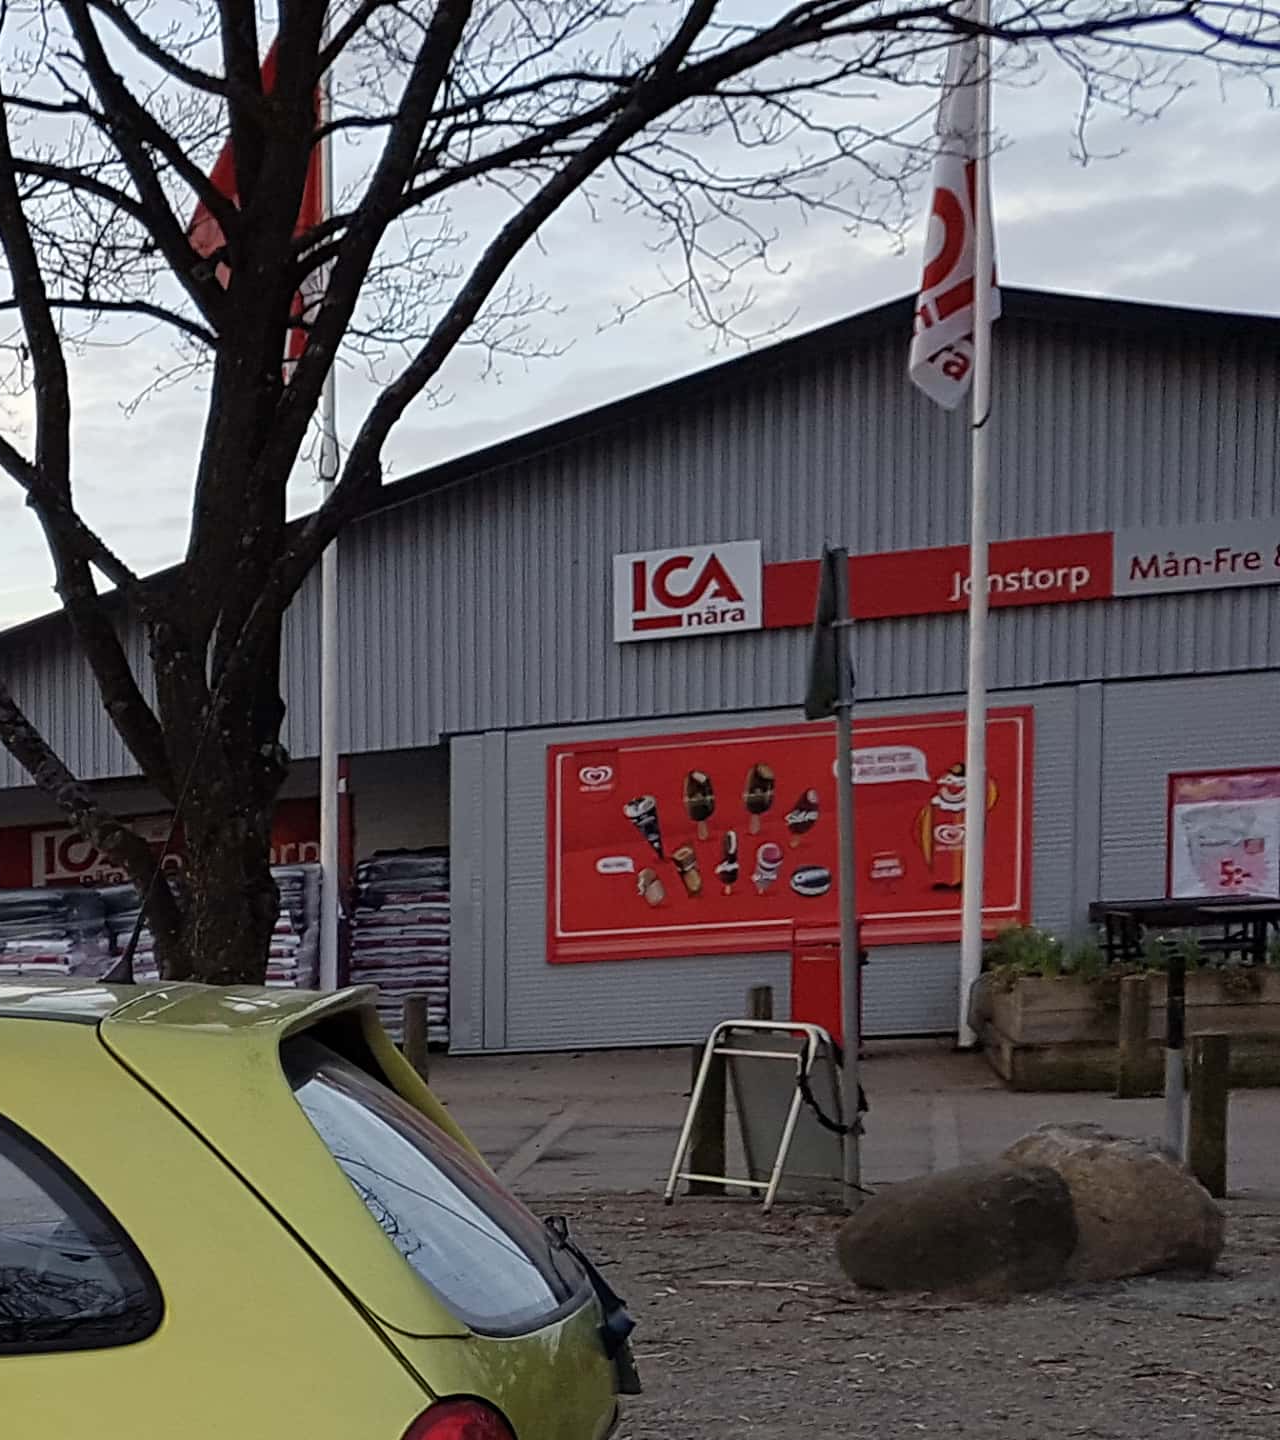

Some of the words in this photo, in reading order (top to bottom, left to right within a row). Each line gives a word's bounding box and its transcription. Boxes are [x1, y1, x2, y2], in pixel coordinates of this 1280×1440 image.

[1129, 548, 1261, 580] Mån-Fre
[632, 552, 744, 612] ICA
[686, 605, 746, 627] nära
